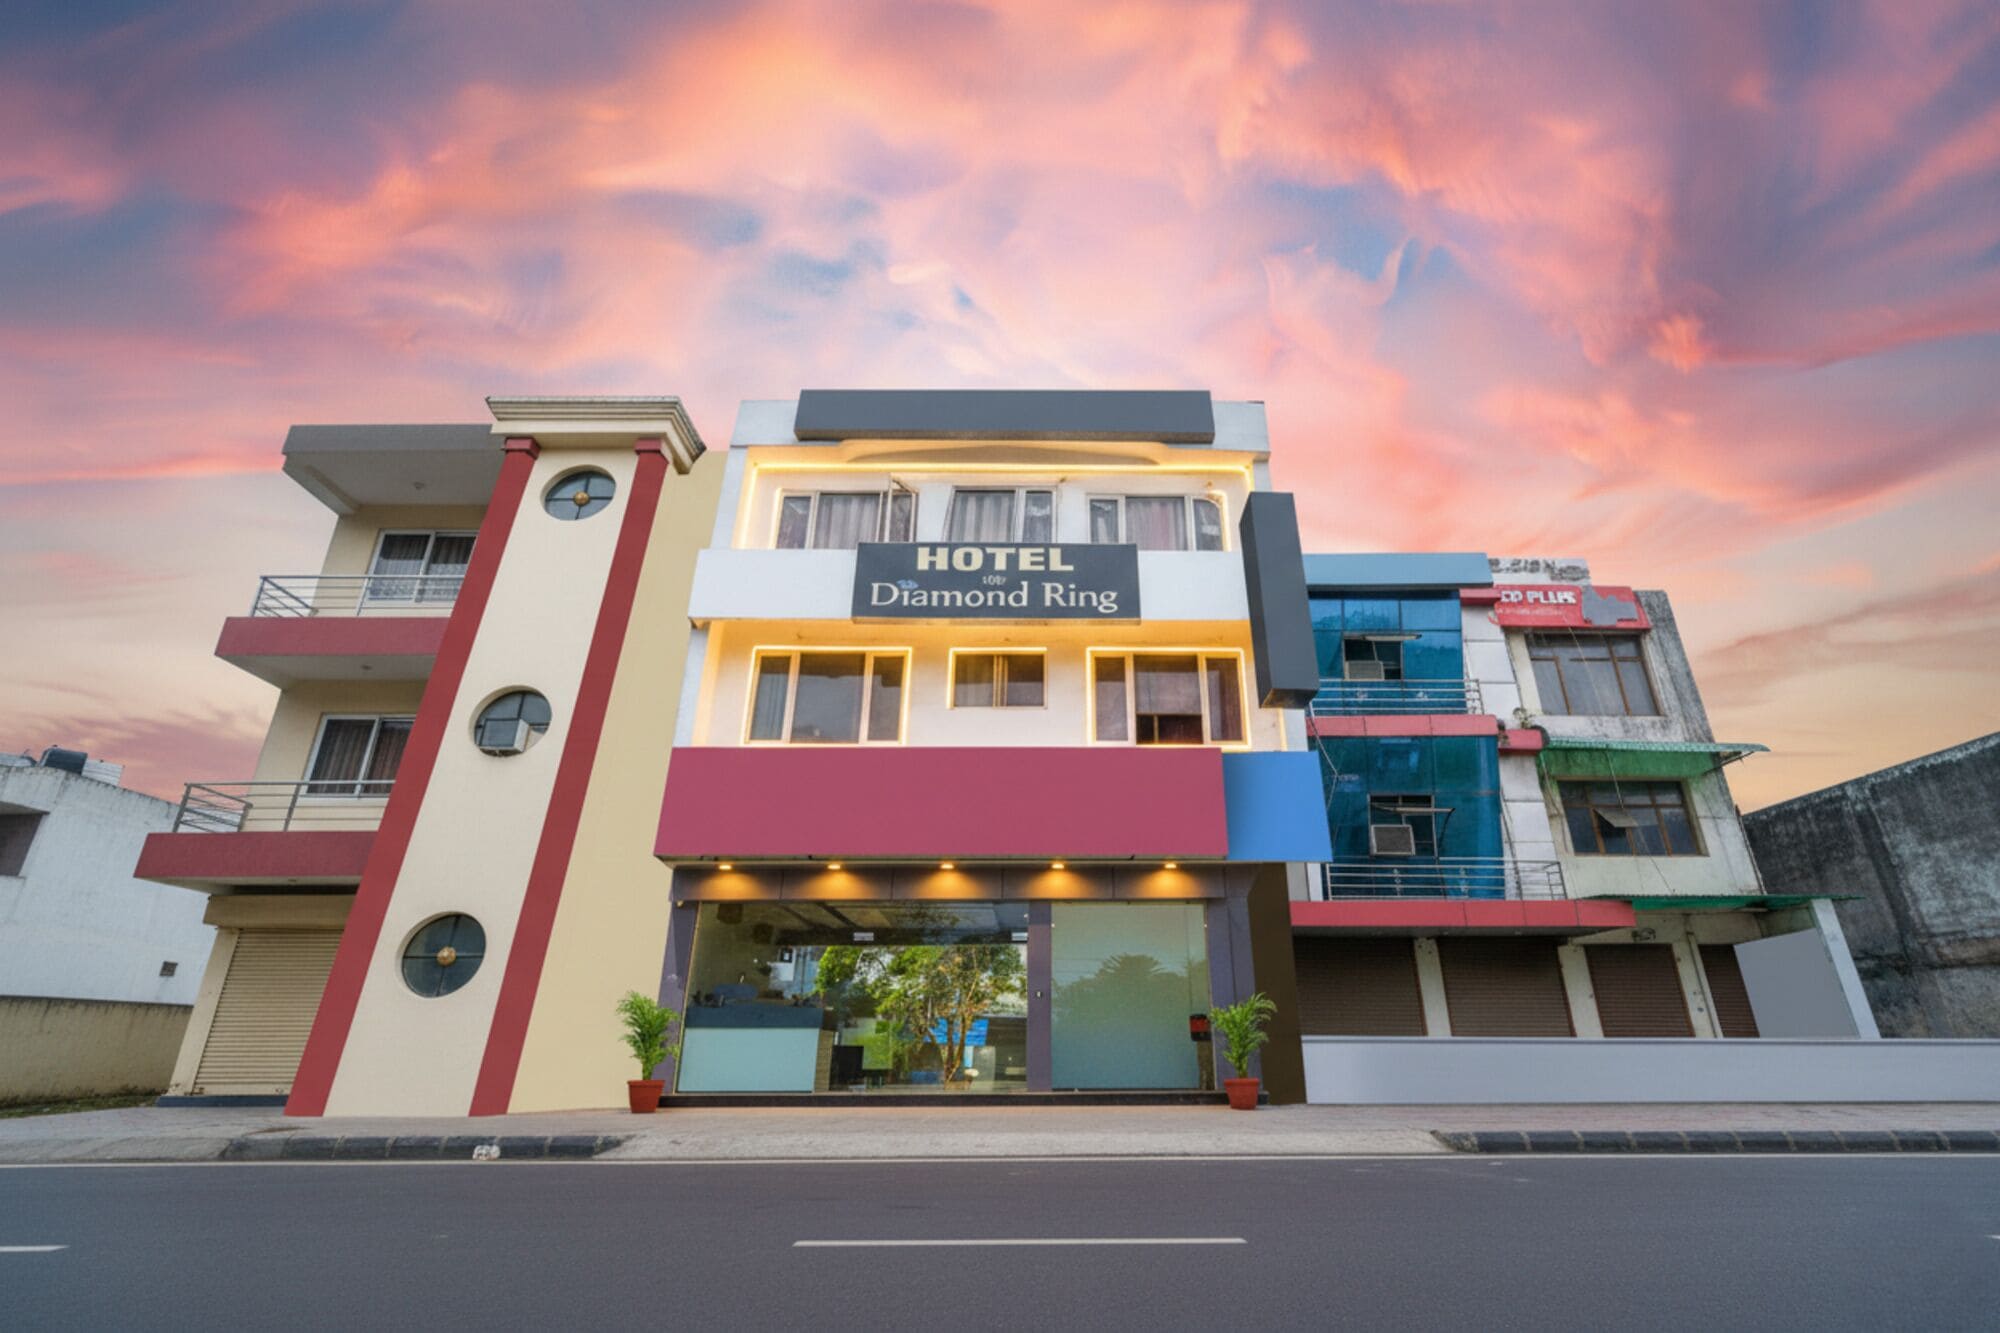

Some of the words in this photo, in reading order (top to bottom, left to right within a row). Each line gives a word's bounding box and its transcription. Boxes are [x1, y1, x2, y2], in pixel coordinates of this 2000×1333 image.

[917, 546, 1074, 571] HOTEL
[870, 581, 1029, 608] Diamond
[1043, 583, 1118, 614] Ring
